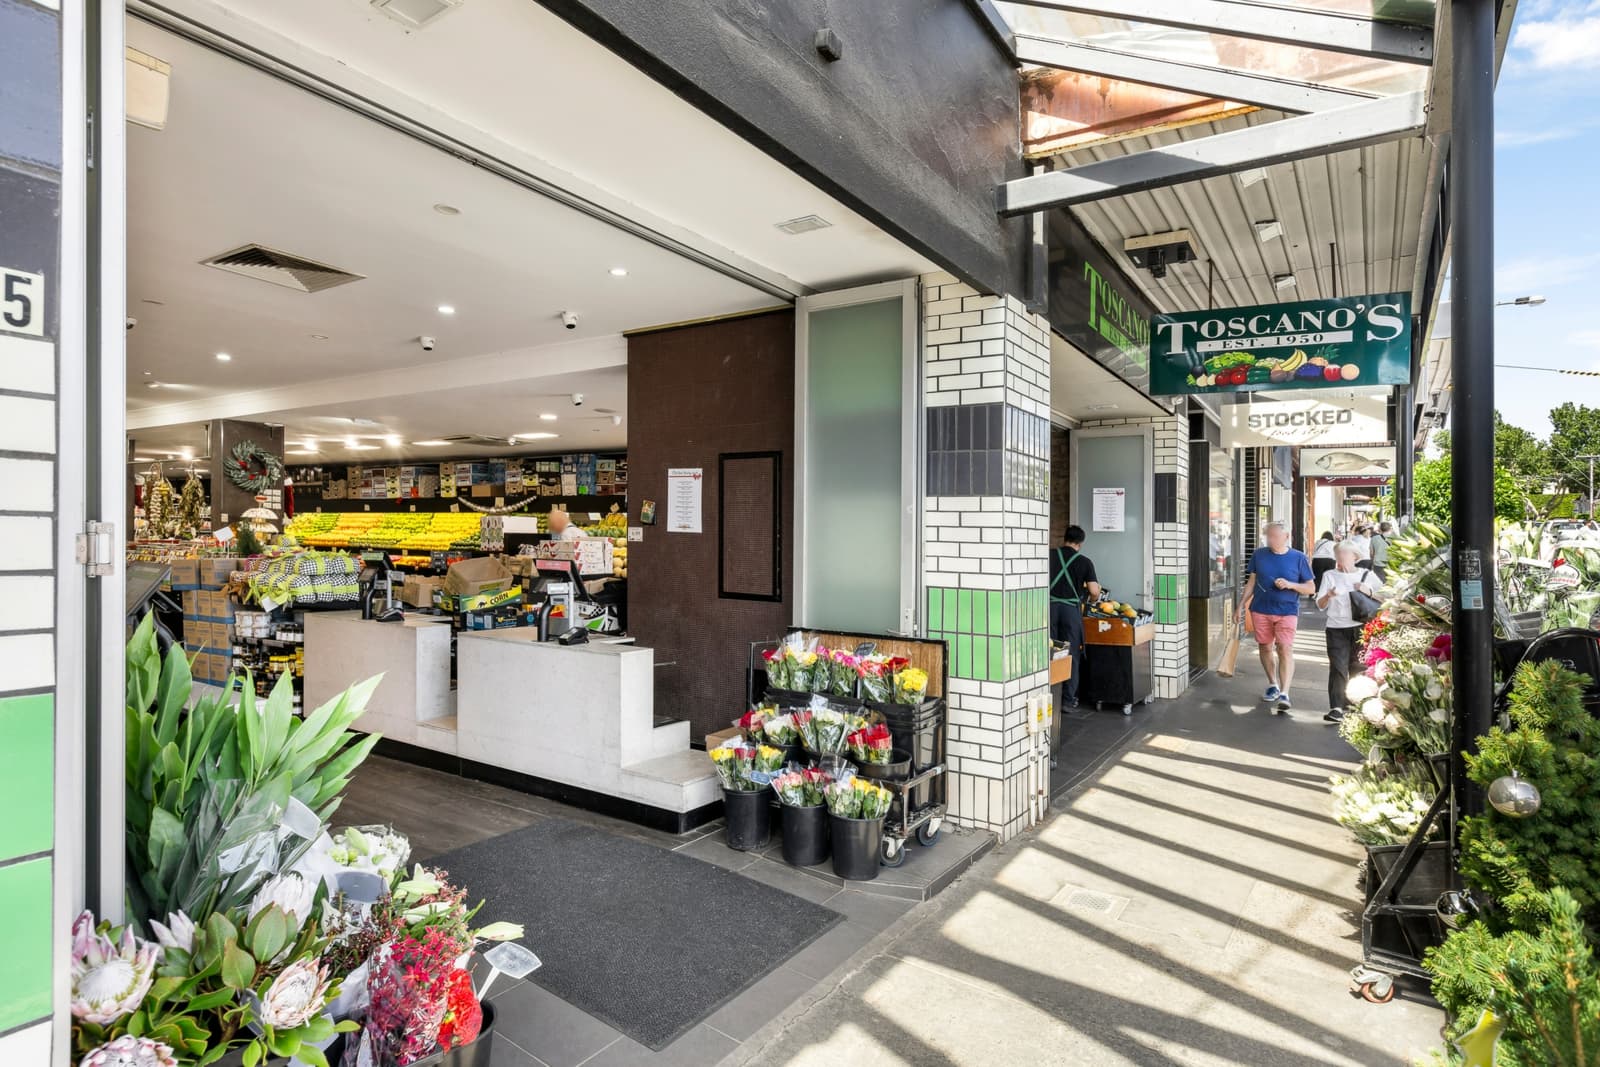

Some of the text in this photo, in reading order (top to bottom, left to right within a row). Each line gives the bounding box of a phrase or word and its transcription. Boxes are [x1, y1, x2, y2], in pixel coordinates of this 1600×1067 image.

[3, 273, 32, 327] 5
[1157, 303, 1404, 355] TOSCANO'S
[1222, 334, 1324, 349] EST. 1950
[1248, 409, 1352, 428] STOCKED
[490, 592, 509, 605] CORN
